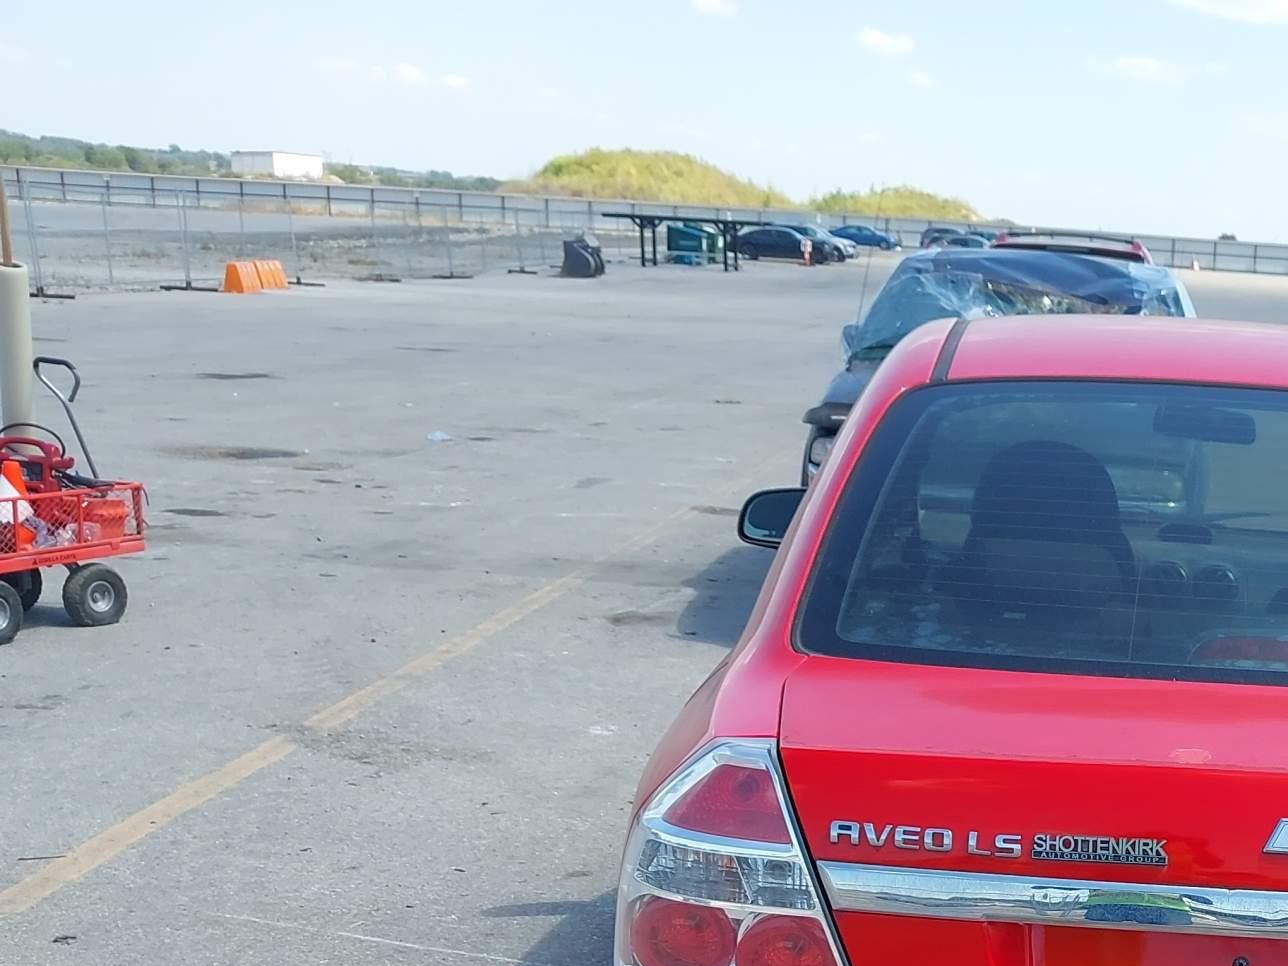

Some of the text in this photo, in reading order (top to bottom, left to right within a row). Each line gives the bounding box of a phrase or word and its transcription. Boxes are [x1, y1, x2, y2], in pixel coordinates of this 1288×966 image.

[829, 820, 1022, 858] AVEO LS
[1033, 834, 1168, 857] SHOTTENKIRK
[1040, 851, 1160, 864] AUTOMOTIVE GROUP
